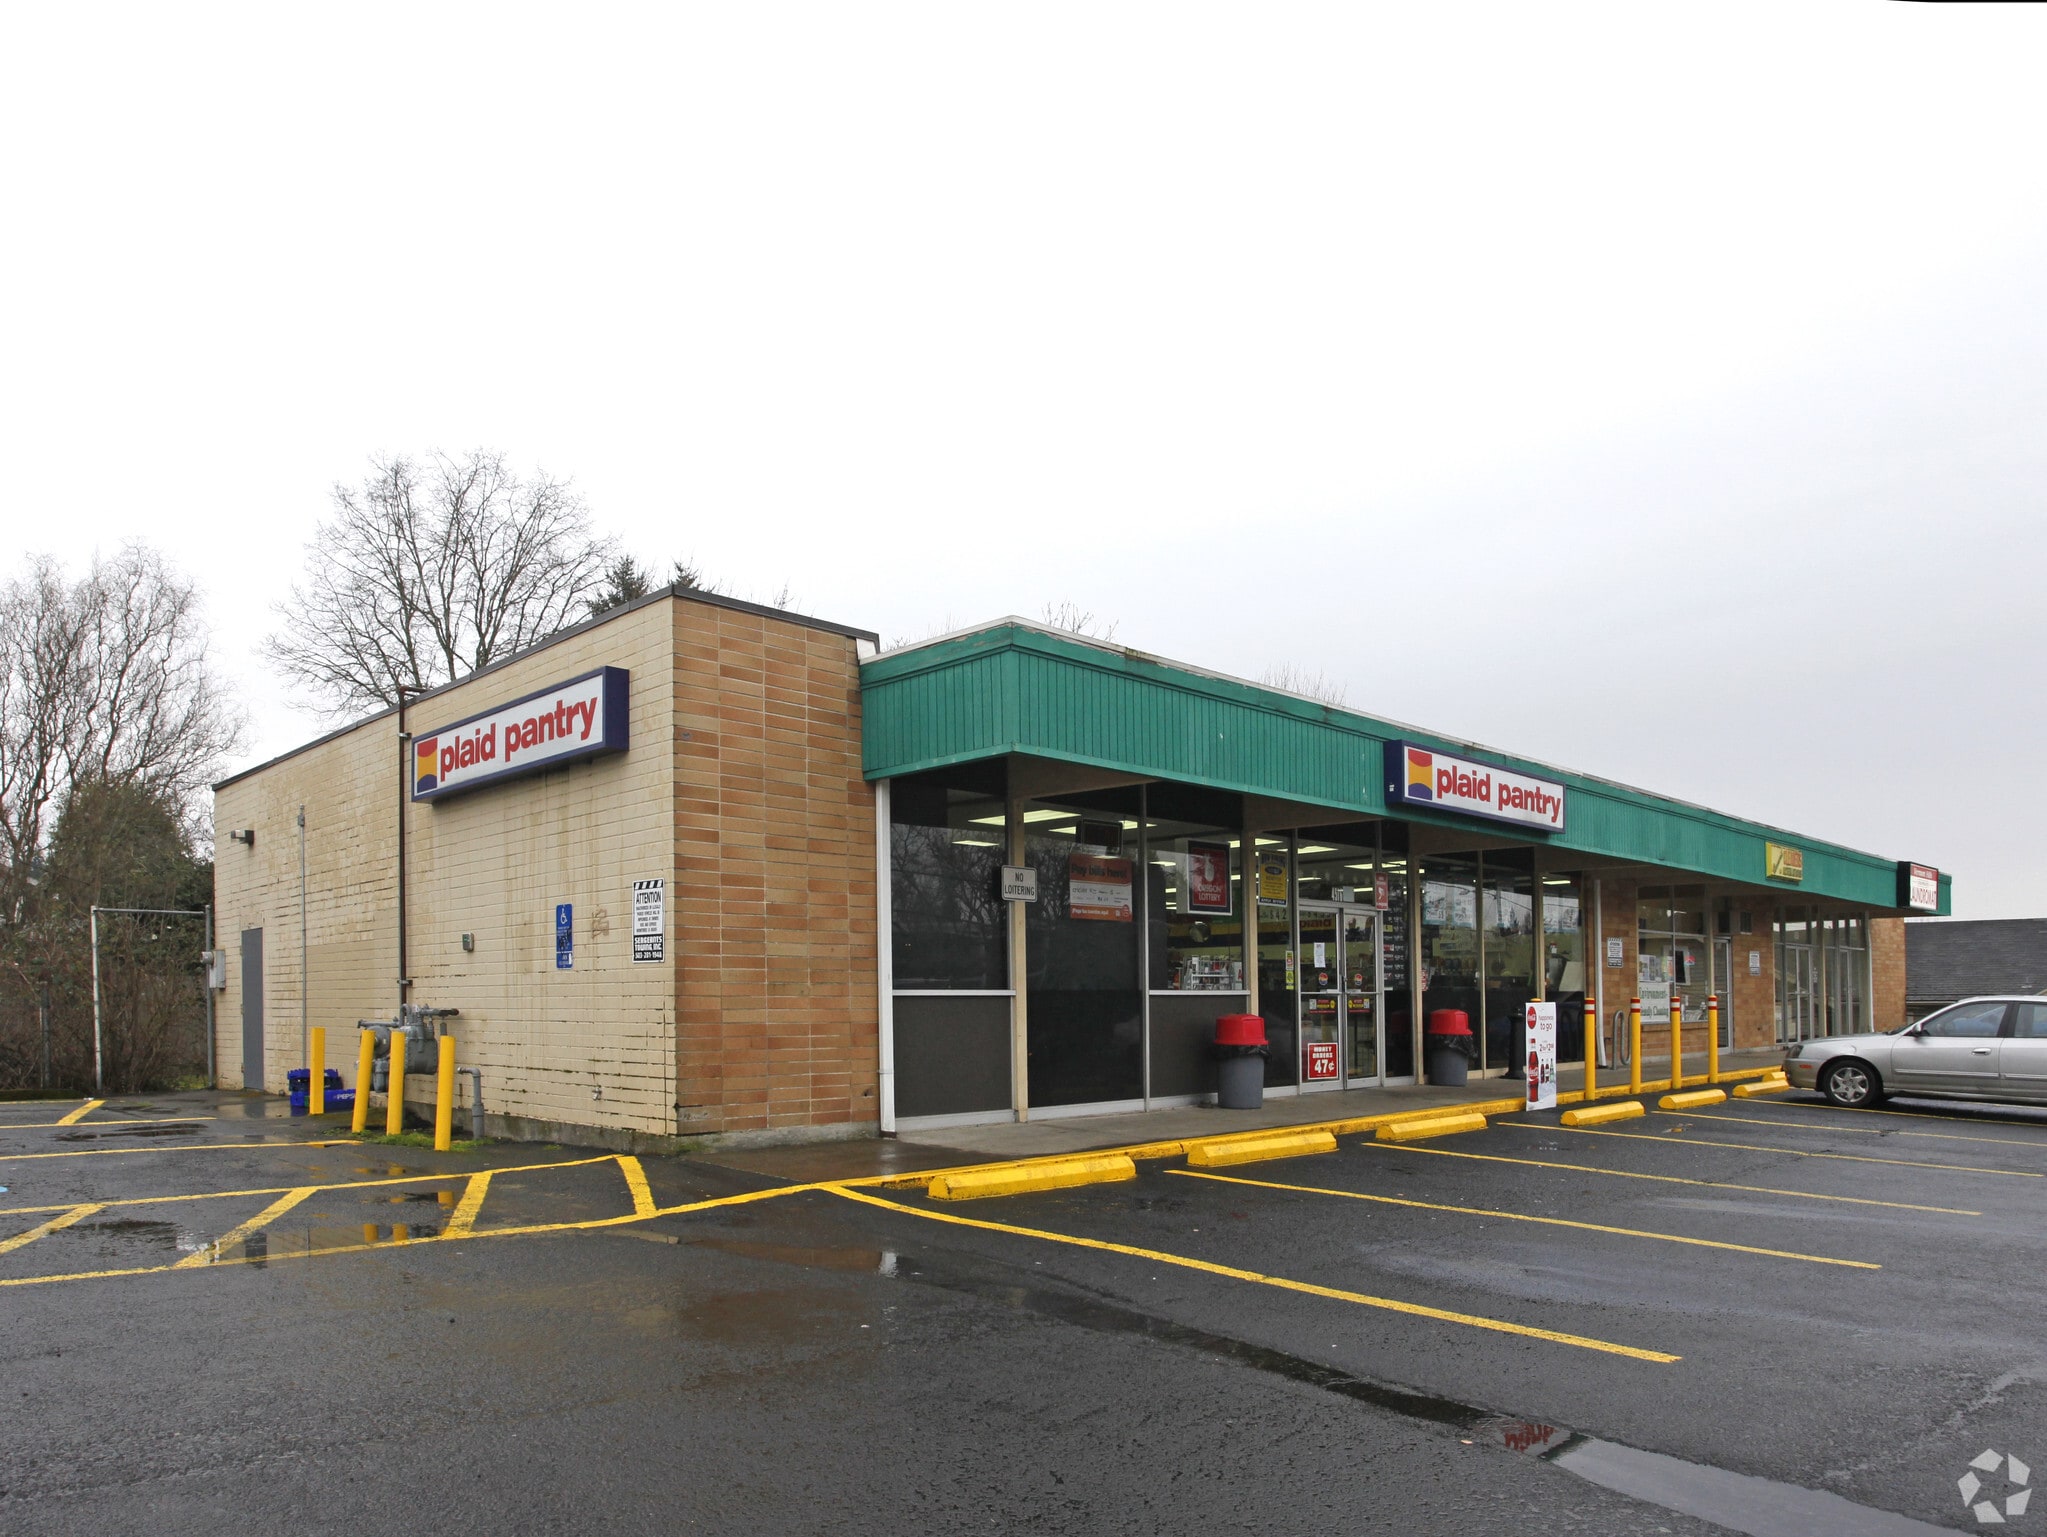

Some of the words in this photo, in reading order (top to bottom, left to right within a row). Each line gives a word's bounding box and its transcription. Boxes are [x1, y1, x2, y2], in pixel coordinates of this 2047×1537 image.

[440, 722, 496, 782] plaid
[505, 697, 598, 762] pantry
[1437, 765, 1491, 803] plaid
[1498, 782, 1561, 823] pantry
[1015, 872, 1023, 881] NO
[1004, 884, 1035, 896] LOITERING
[636, 891, 662, 904] ATTENTION
[1198, 893, 1221, 901] LOTTERY
[1546, 1023, 1552, 1031] go
[1314, 1059, 1335, 1074] 47¢
